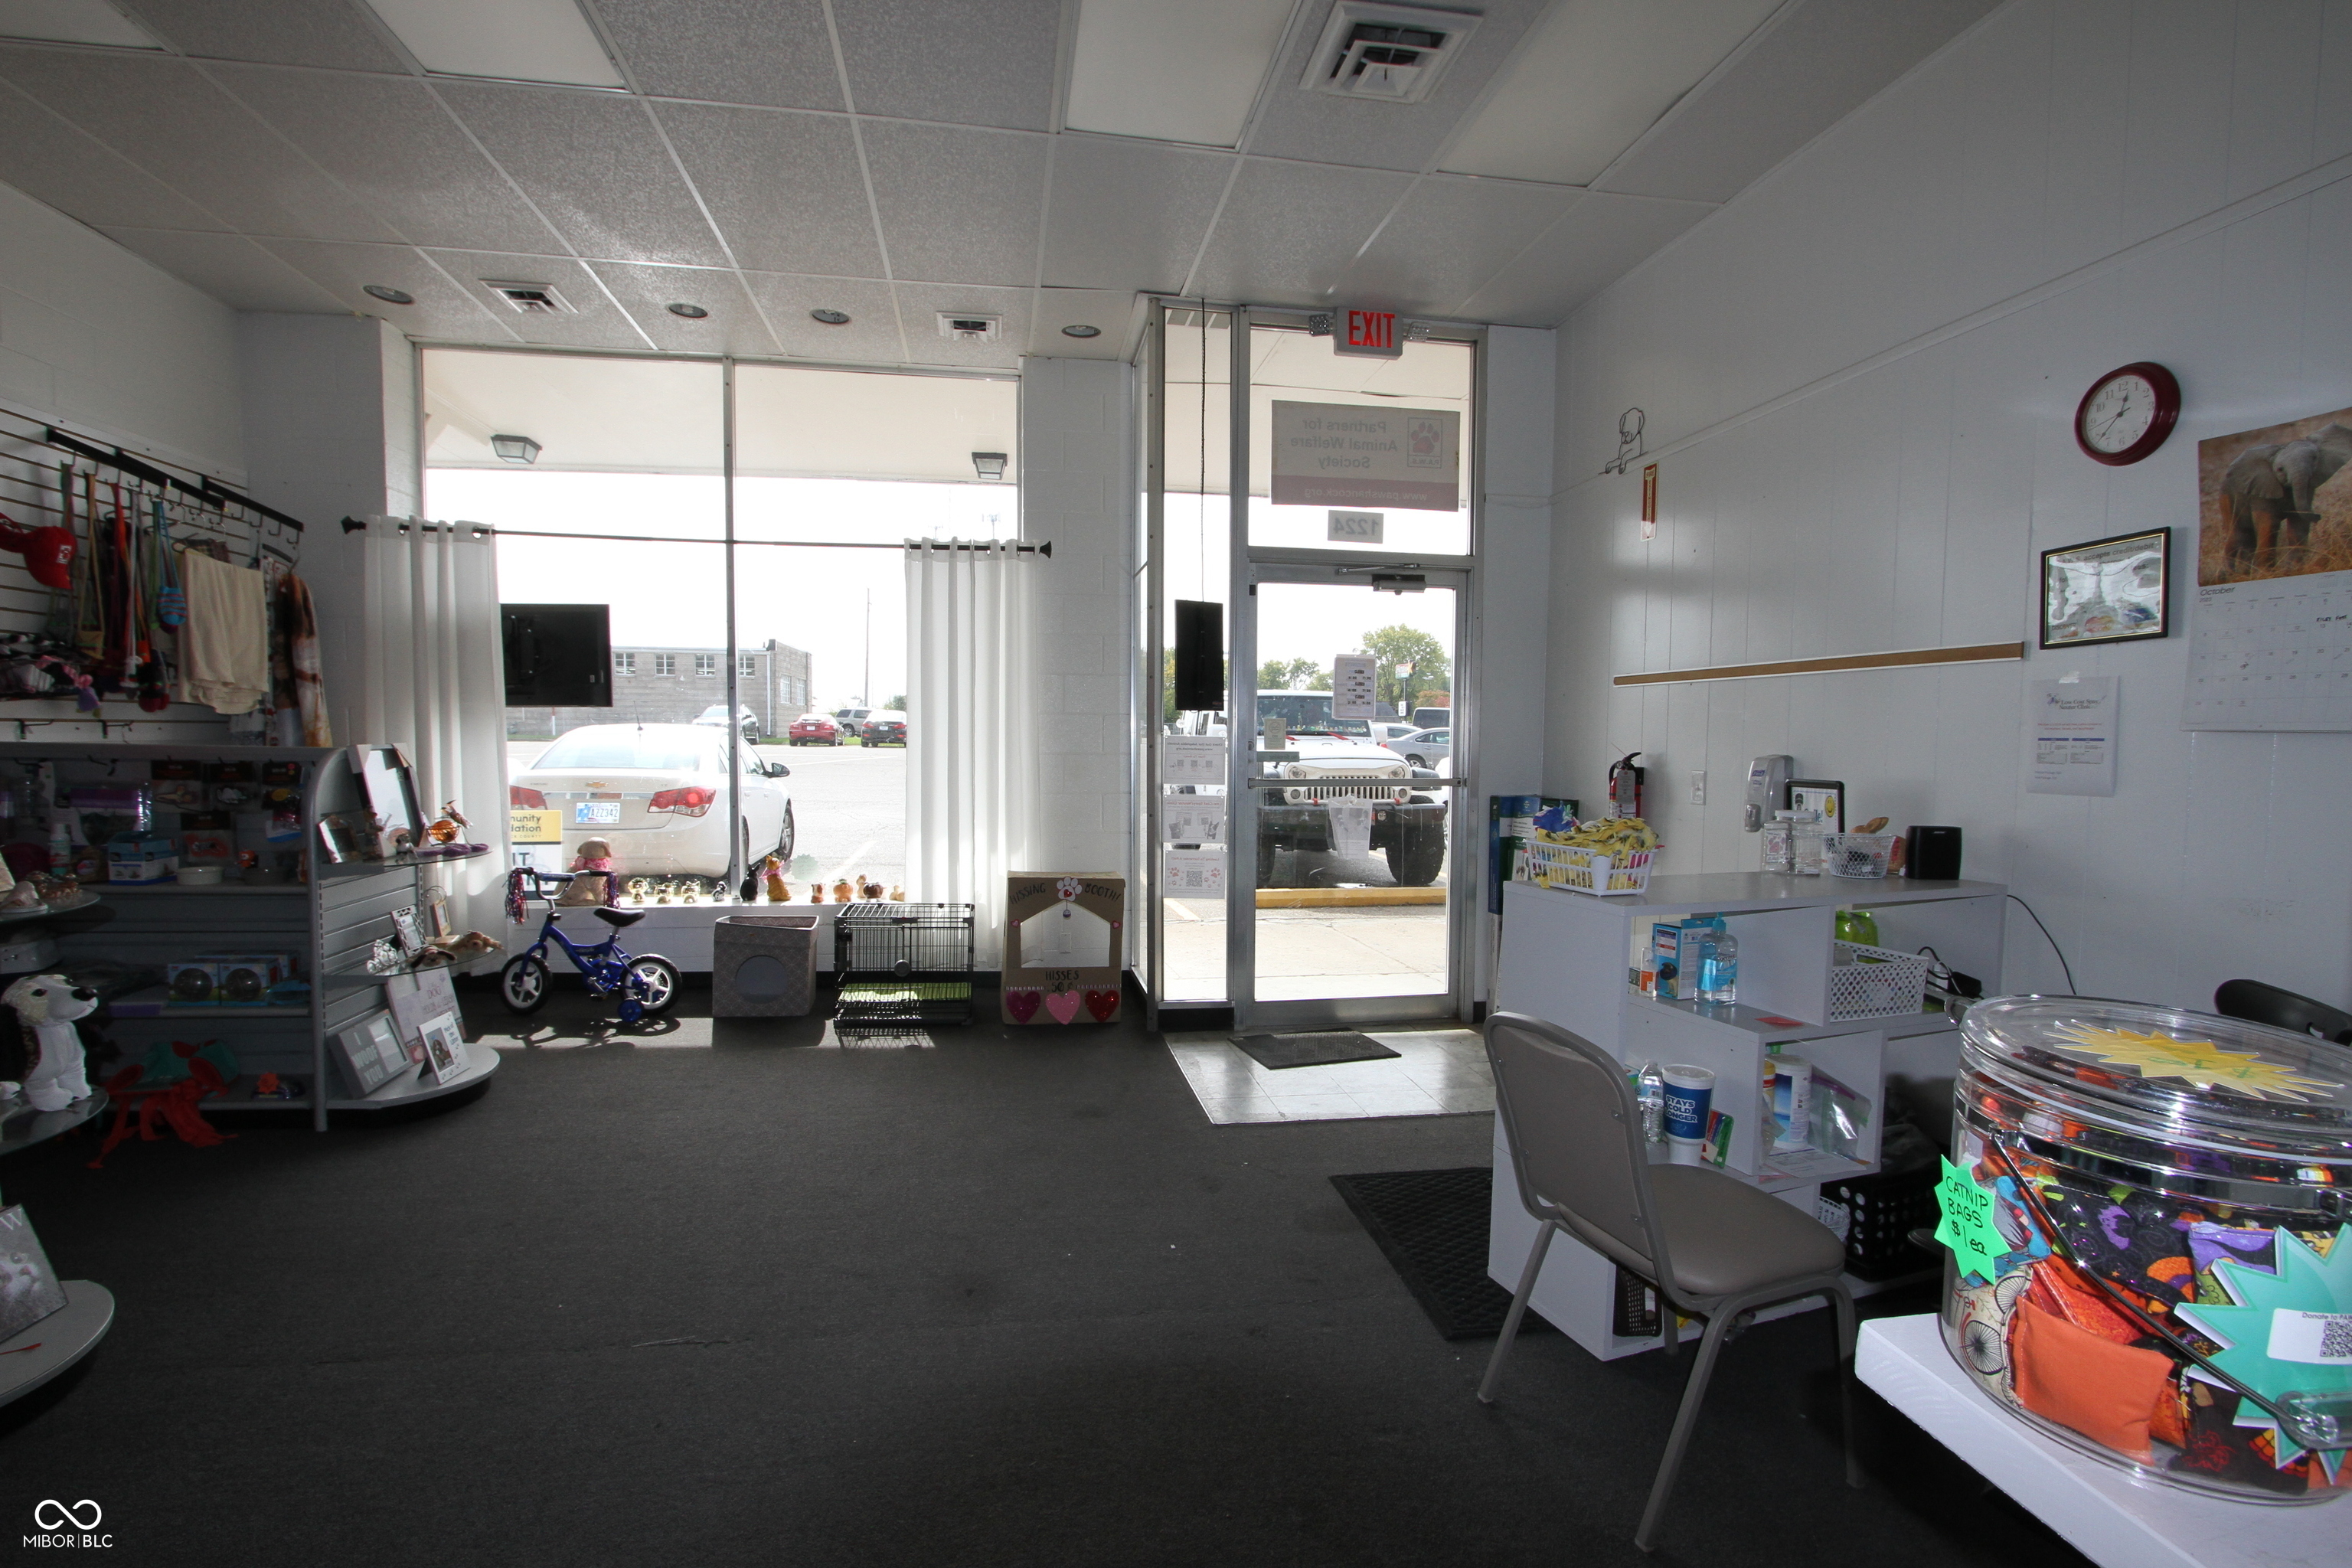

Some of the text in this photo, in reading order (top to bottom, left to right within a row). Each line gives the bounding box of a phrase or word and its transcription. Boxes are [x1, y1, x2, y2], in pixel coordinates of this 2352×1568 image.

[1349, 310, 1395, 348] EXIT
[2118, 381, 2128, 392] 12
[2135, 381, 2138, 391] 1
[2105, 390, 2114, 400] 11
[2143, 387, 2149, 398] 2
[2096, 402, 2105, 412] 10
[2148, 401, 2154, 411] 3
[2083, 551, 2111, 561] accepts
[2112, 542, 2154, 556] credit/debit
[2200, 586, 2235, 596] October
[590, 808, 619, 818] AZZ342
[1009, 882, 1121, 905] HISSING BOOTH!
[1045, 969, 1080, 982] HISSES
[351, 1044, 378, 1070] WOOF
[364, 1063, 384, 1086] YOU
[1666, 1095, 1695, 1108] STAYS
[1668, 1103, 1691, 1114] COLD
[1946, 1175, 1989, 1211] CATNIP
[1947, 1197, 1984, 1229] BAGS
[2301, 1312, 2329, 1320] Donate
